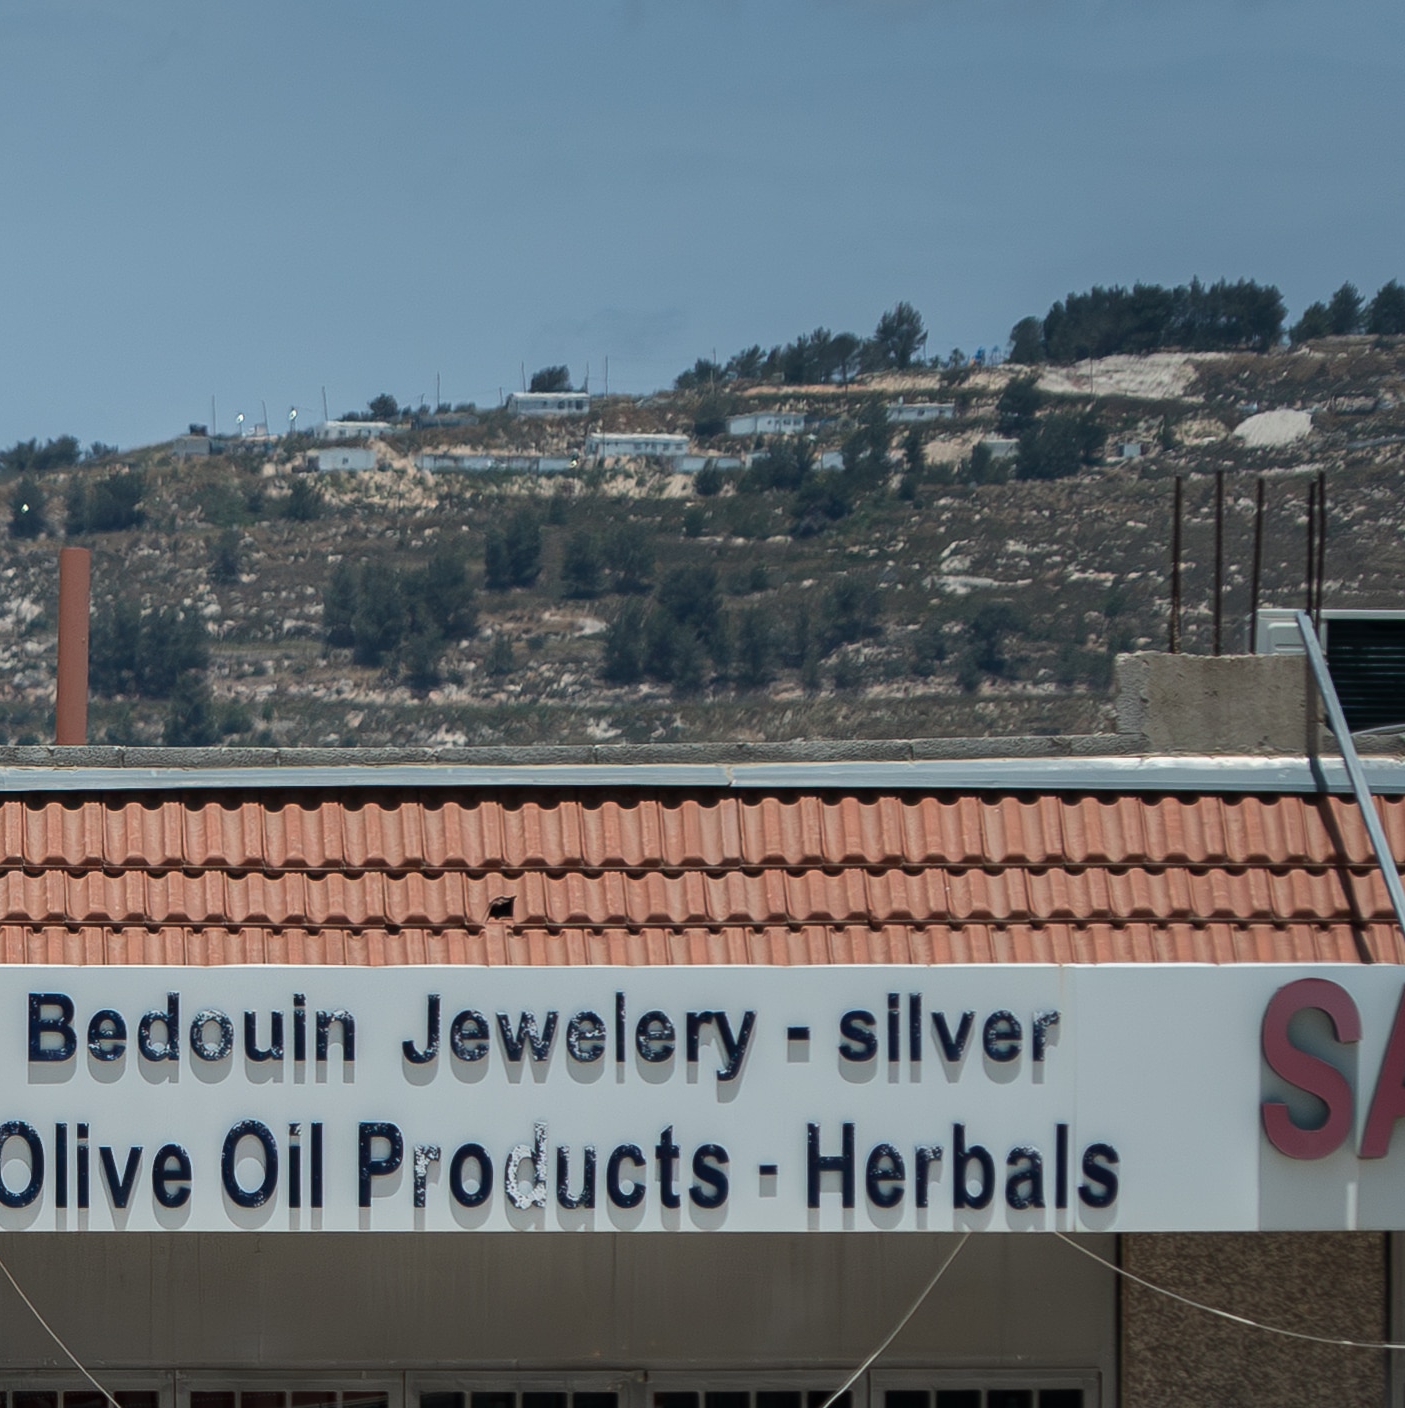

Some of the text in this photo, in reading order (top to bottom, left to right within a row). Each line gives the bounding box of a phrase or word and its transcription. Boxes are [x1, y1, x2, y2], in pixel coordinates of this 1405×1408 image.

[26, 991, 357, 1063] Bedouin
[401, 991, 758, 1082] Jewelery
[838, 991, 1062, 1063] silver
[220, 1119, 324, 1209] Oil
[357, 1119, 730, 1210] Products
[806, 1121, 1120, 1211] Herbals
